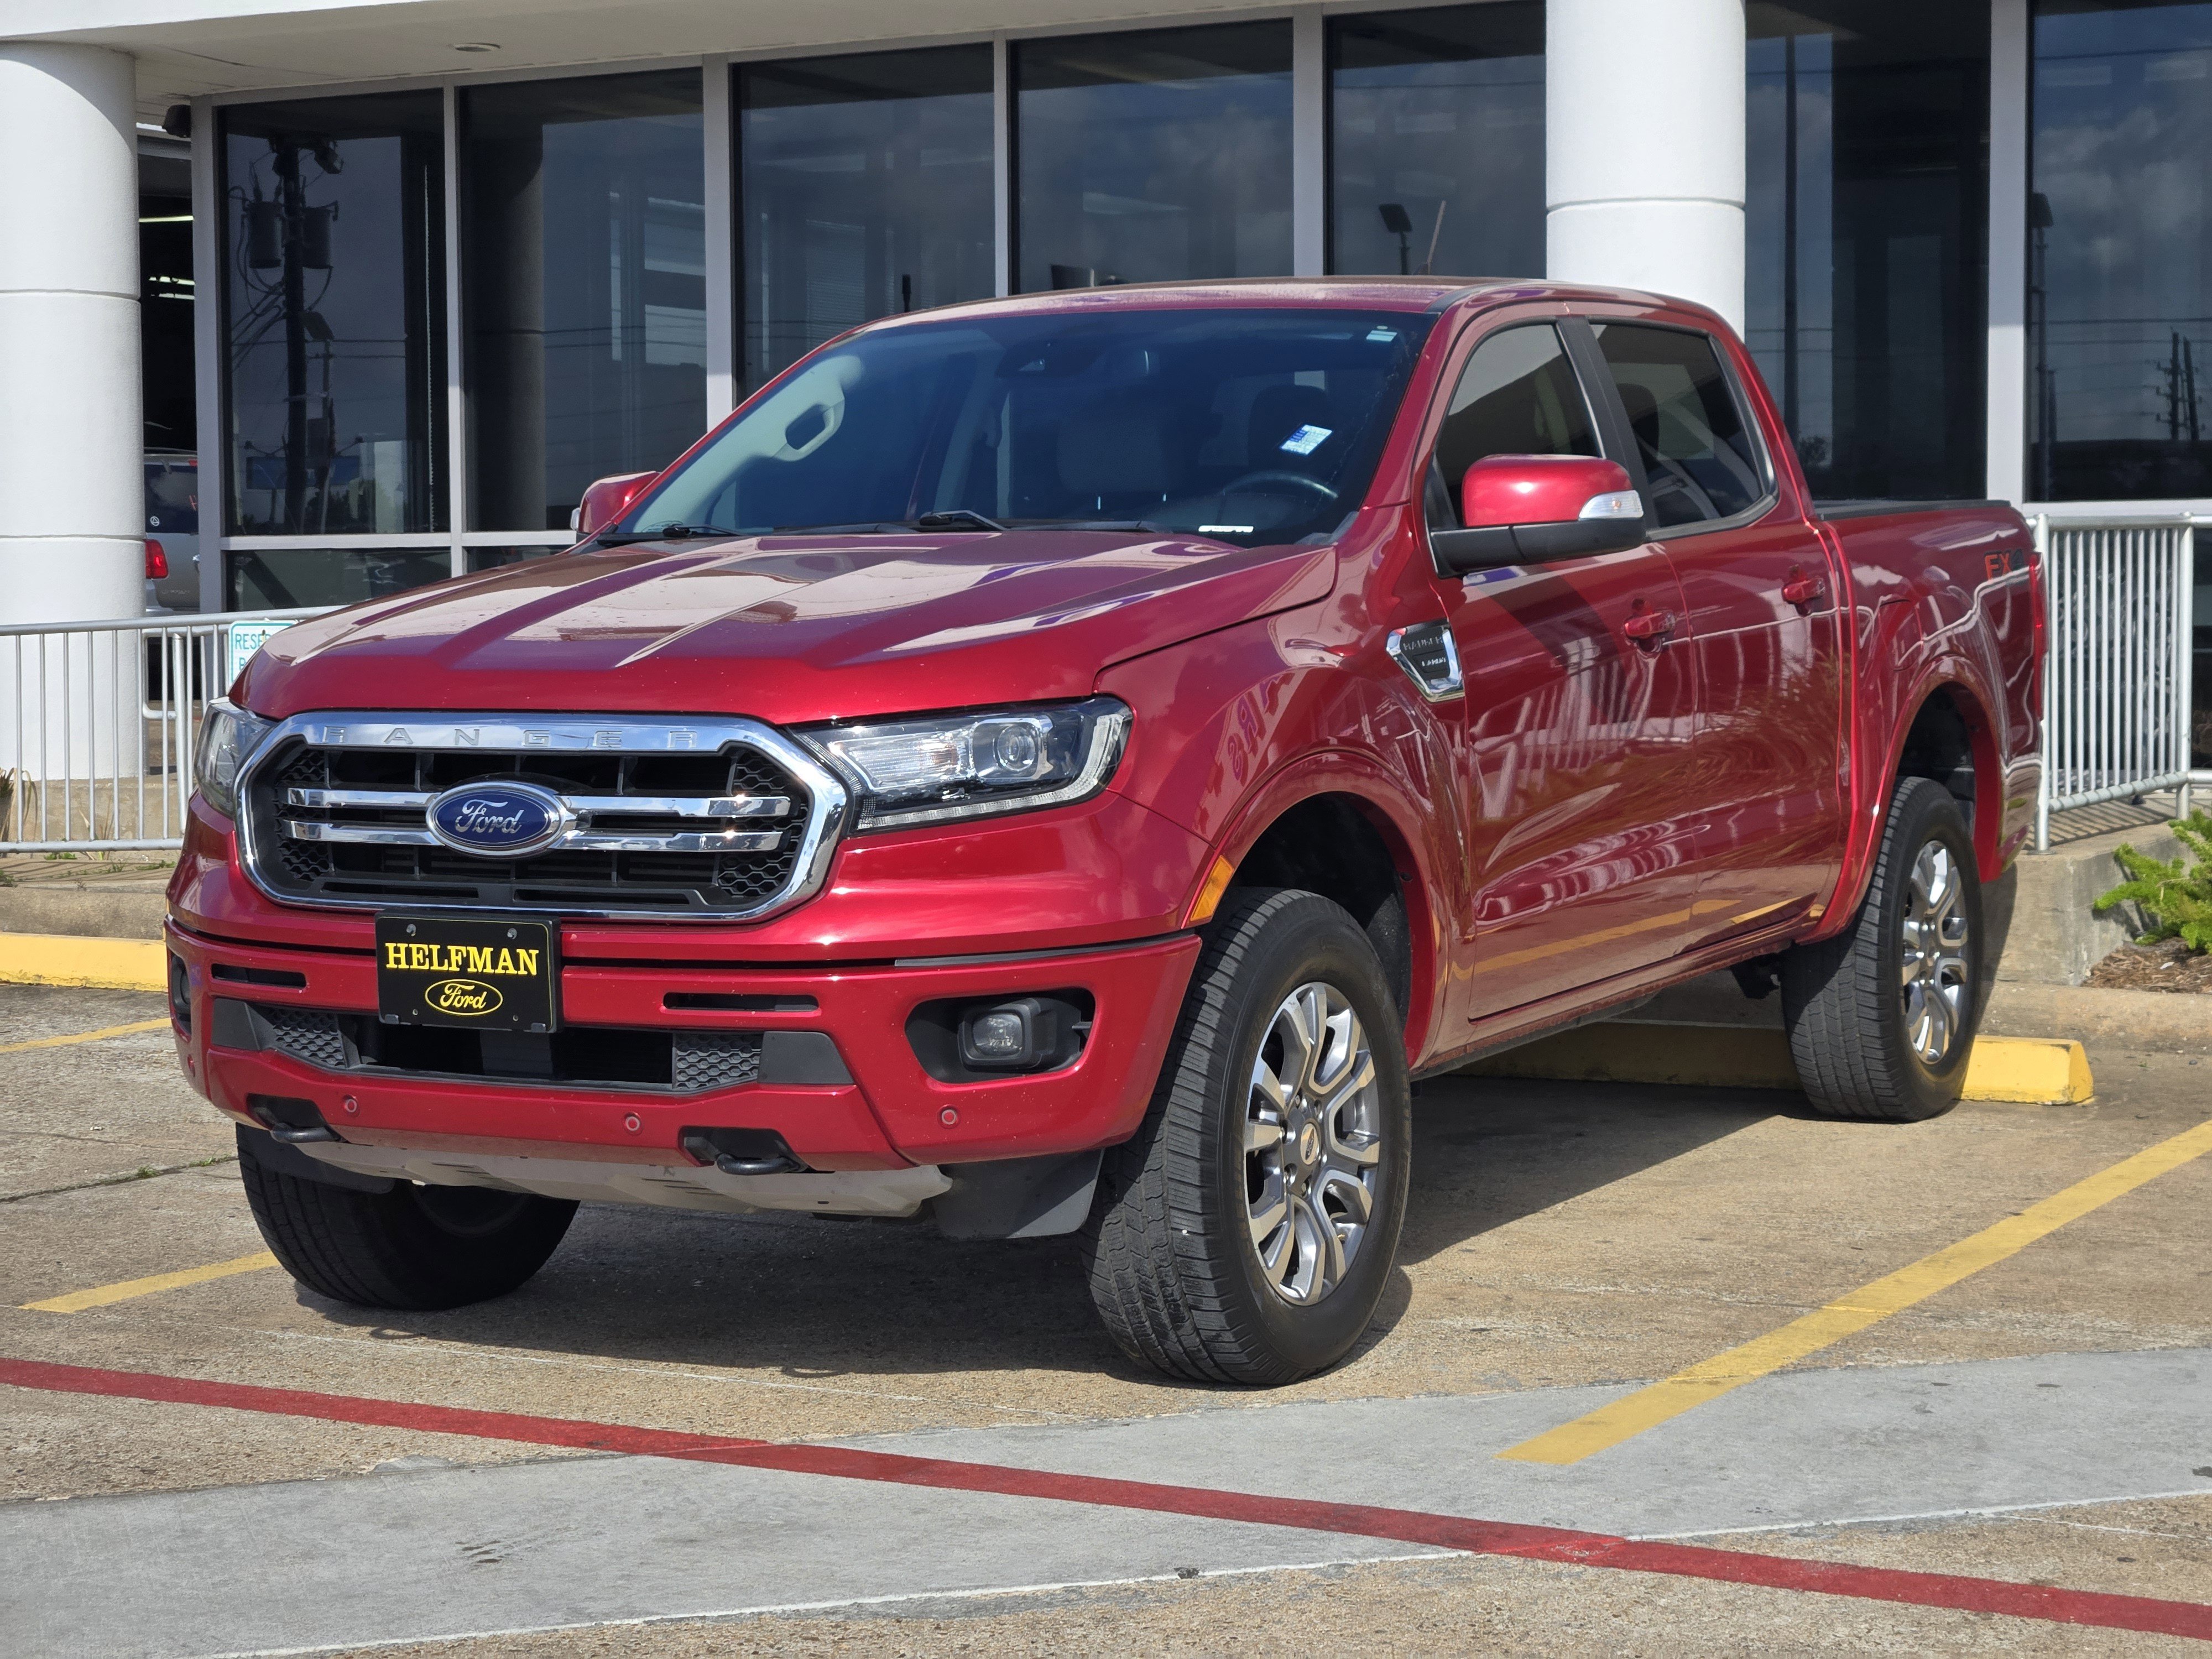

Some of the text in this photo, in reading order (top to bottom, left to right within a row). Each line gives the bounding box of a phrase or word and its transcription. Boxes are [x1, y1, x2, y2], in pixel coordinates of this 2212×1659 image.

[323, 726, 698, 749] RANGER
[455, 799, 524, 833] Ford
[385, 942, 539, 975] HELFMAN
[440, 983, 488, 1009] Ford
